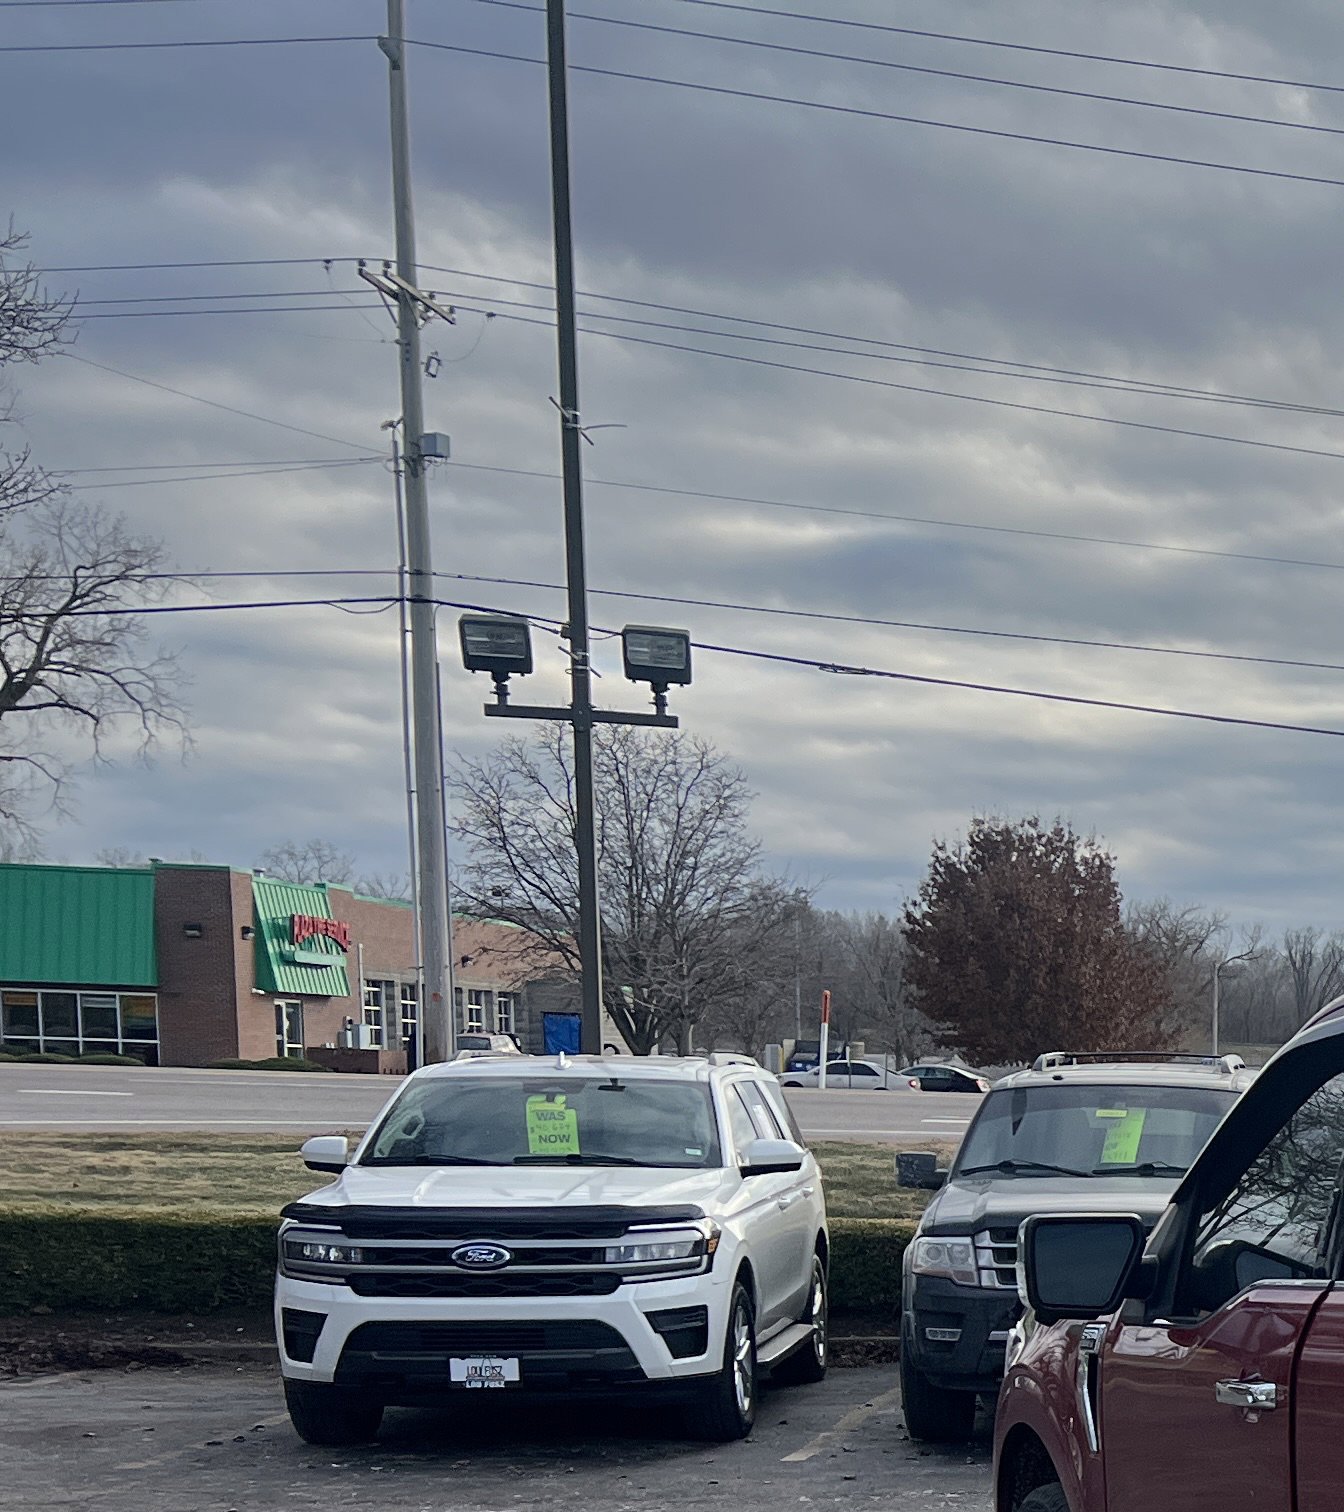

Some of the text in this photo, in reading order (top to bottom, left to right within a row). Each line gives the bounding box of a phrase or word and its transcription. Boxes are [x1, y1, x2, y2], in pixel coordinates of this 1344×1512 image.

[535, 1111, 566, 1121] WAS
[538, 1134, 571, 1144] NOW
[466, 1249, 496, 1262] Ford
